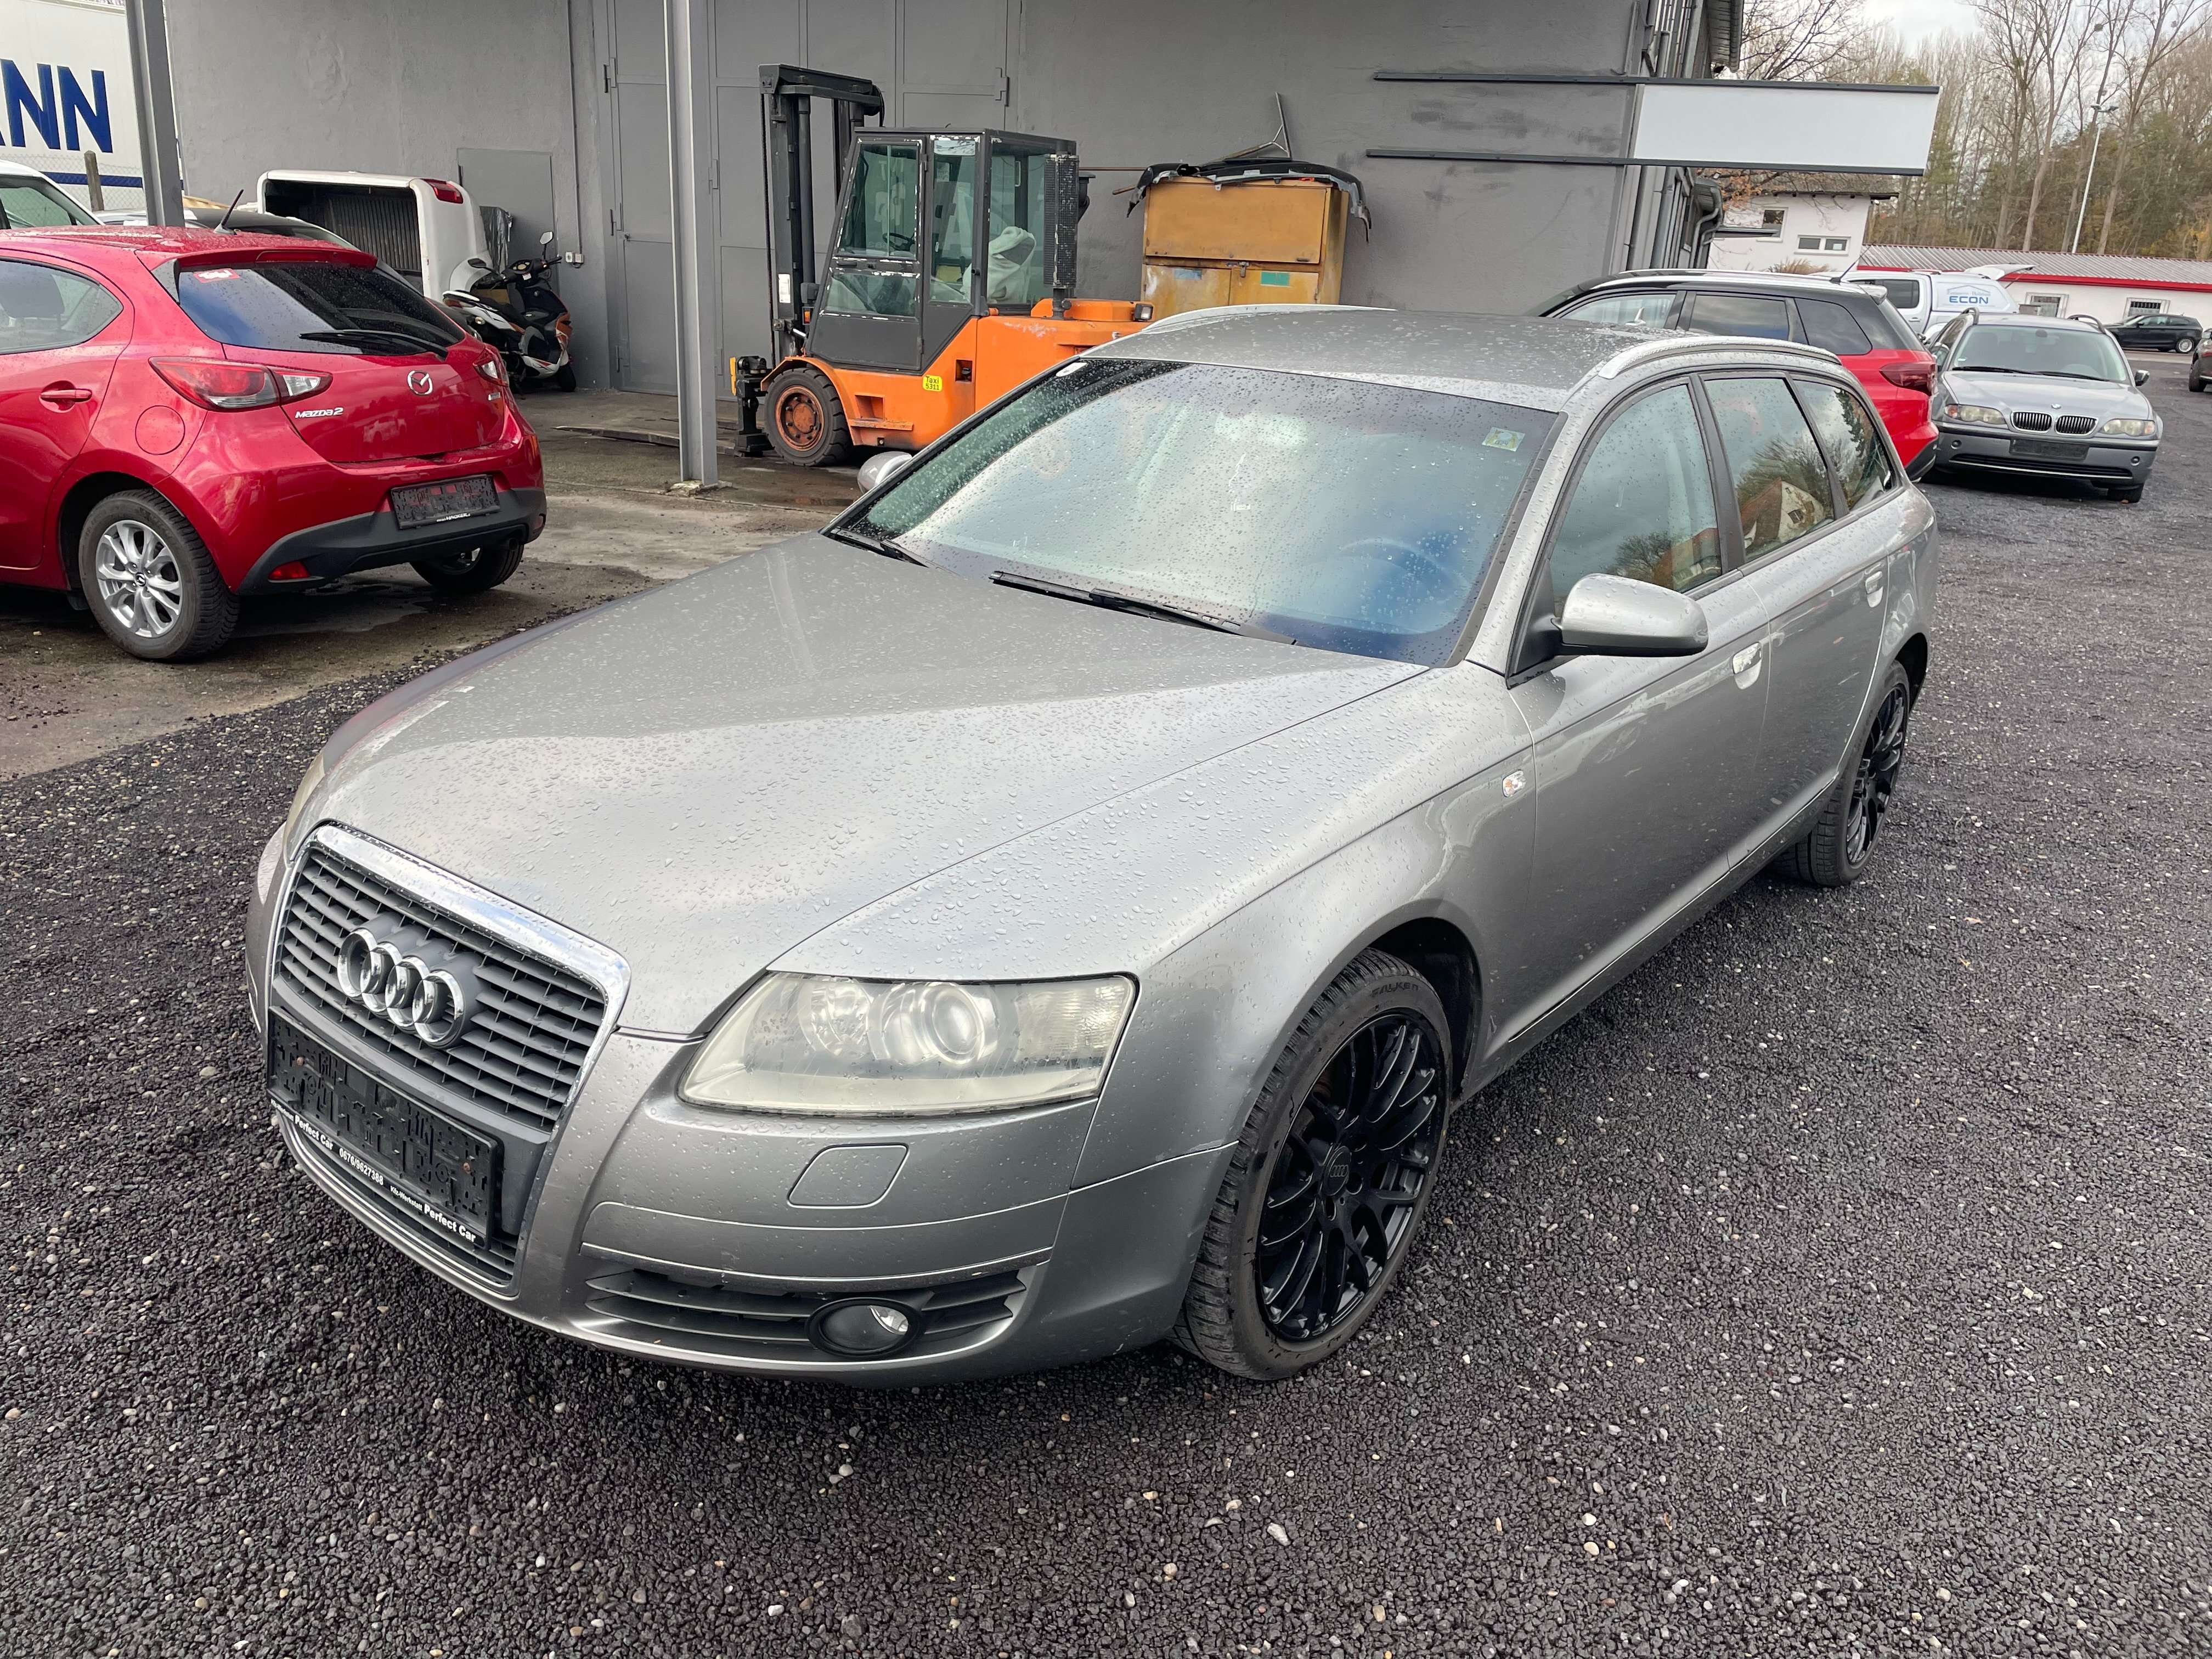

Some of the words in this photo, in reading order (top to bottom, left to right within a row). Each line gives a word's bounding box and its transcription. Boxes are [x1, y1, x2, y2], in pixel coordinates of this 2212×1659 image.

[0, 59, 113, 153] NN
[1949, 296, 1989, 304] ECON
[295, 1115, 320, 1141] Perfect
[320, 1135, 334, 1150] Car
[339, 1148, 384, 1186] 0676/9627388
[390, 1186, 423, 1211] Kfz-Werkstatt
[424, 1203, 457, 1232] Perfect
[459, 1225, 476, 1243] Car
